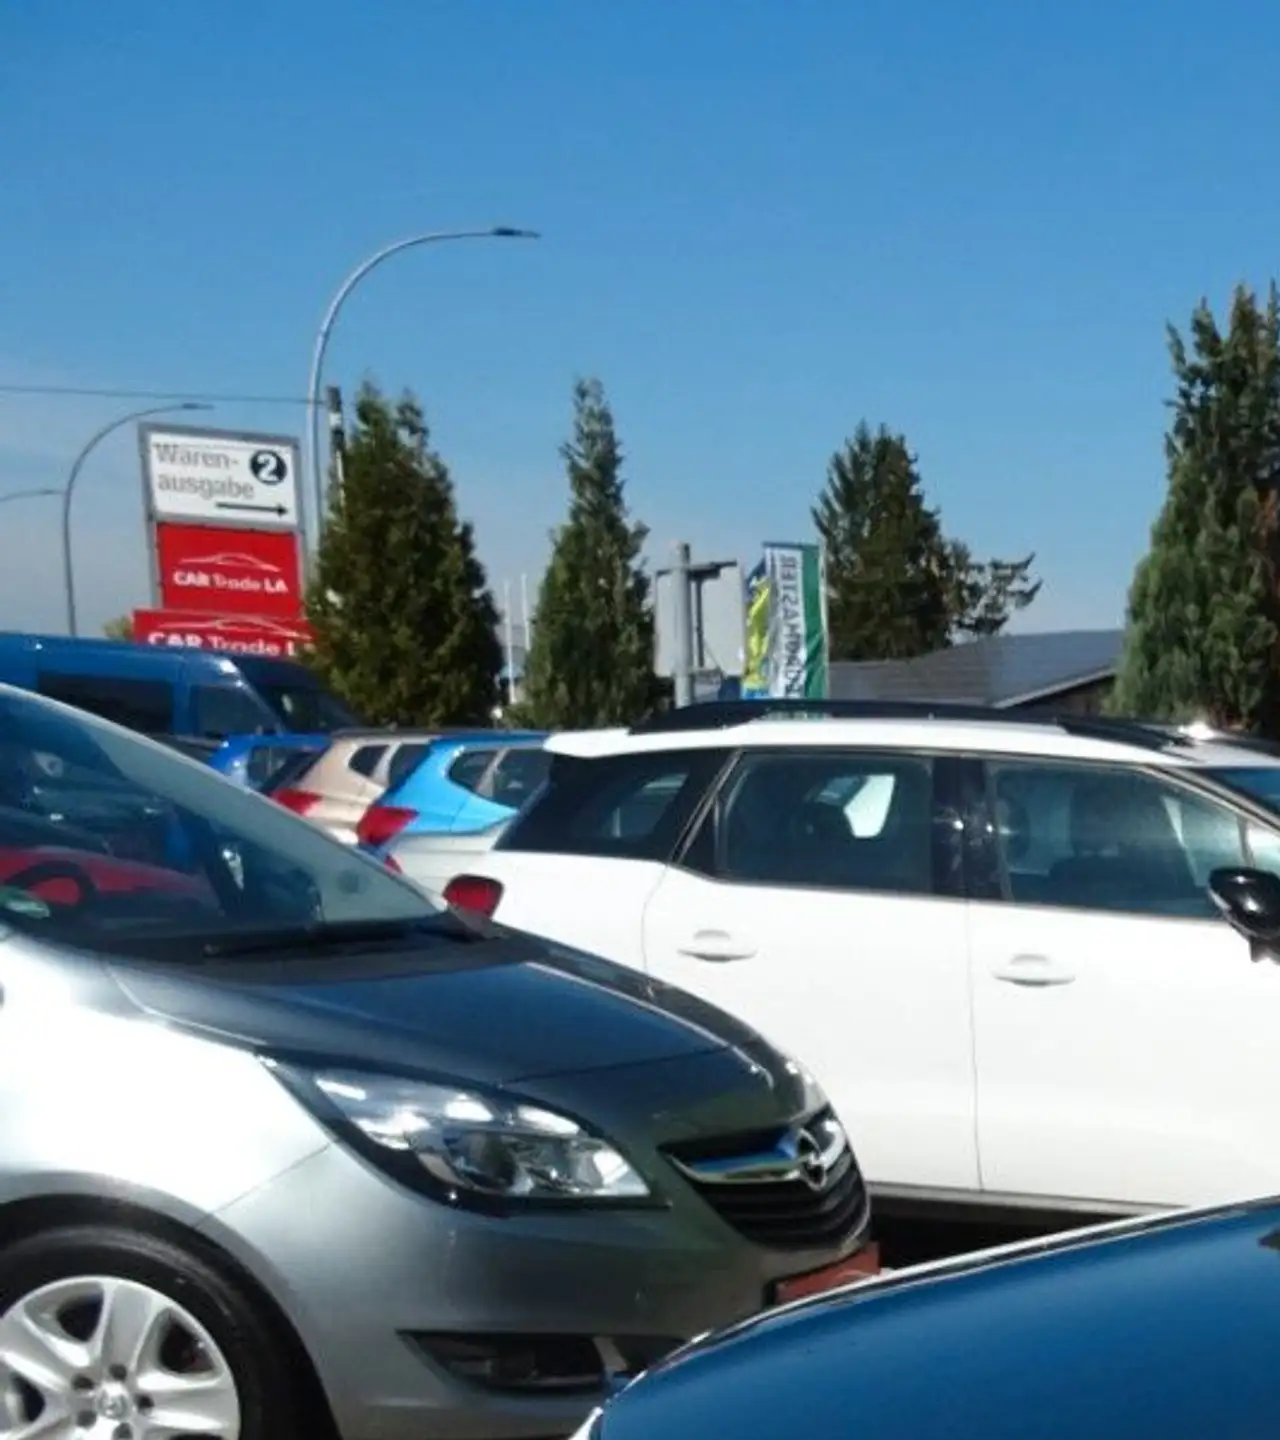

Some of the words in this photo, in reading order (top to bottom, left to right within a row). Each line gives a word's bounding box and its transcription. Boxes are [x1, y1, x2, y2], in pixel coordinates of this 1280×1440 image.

[153, 443, 239, 469] Waren-
[255, 452, 283, 482] 2
[157, 474, 255, 500] ausgabe
[173, 569, 209, 587] CAR
[264, 576, 289, 594] LA
